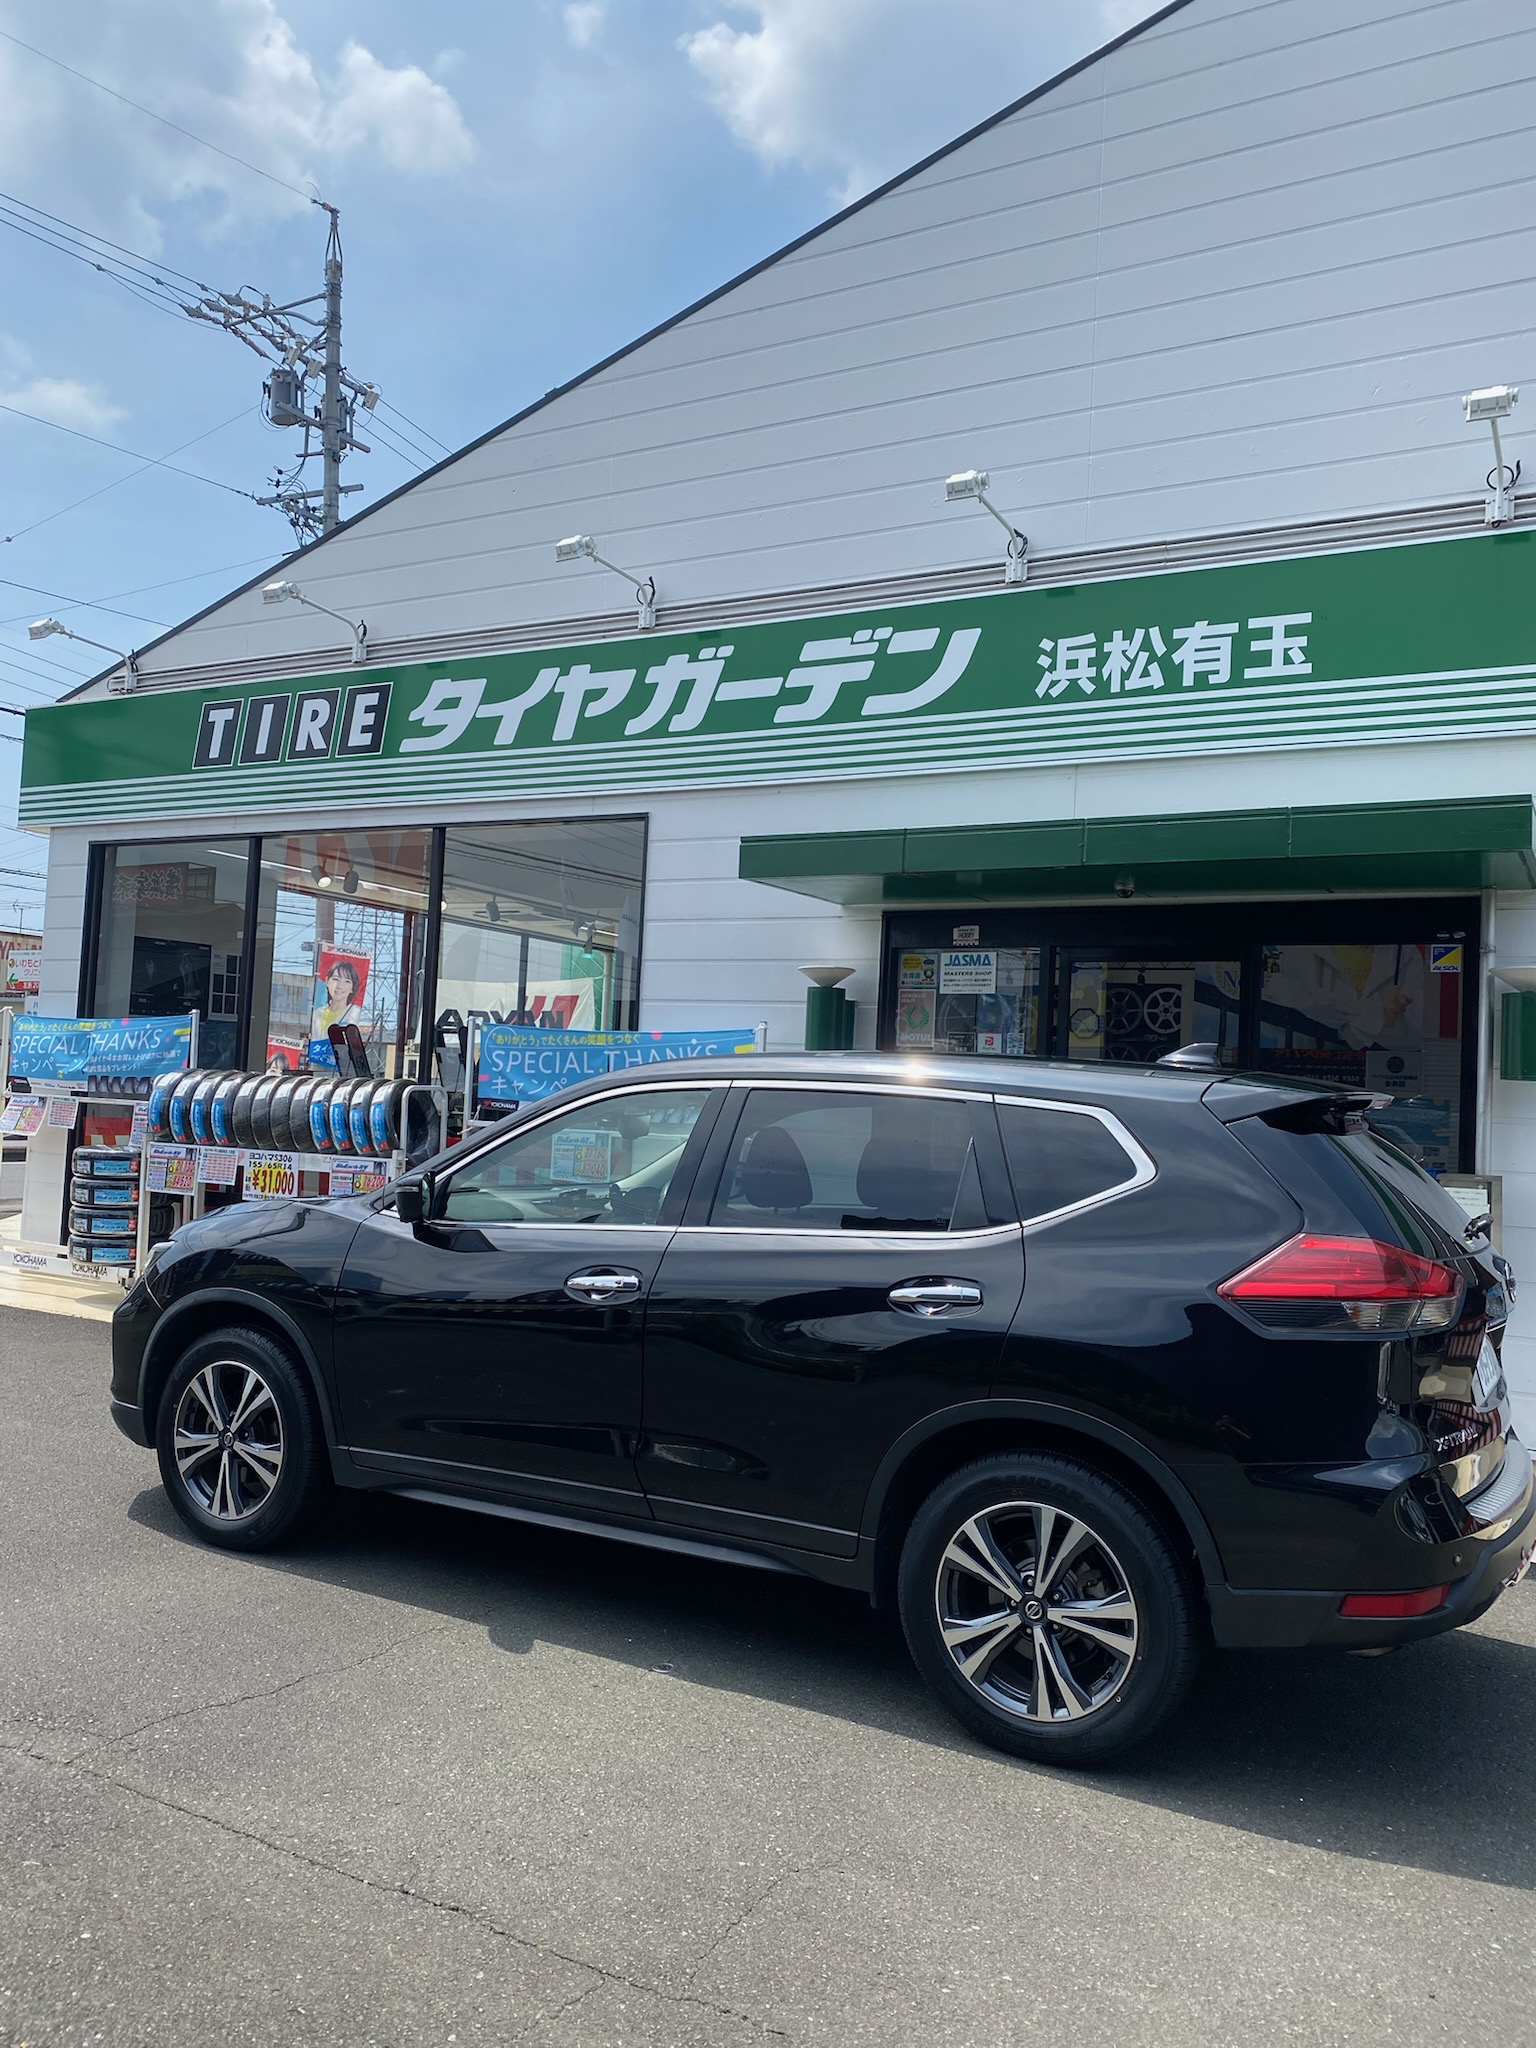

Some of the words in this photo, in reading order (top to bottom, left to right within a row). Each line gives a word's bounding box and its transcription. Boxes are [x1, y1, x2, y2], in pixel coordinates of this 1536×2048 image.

[1035, 611, 1313, 699] 浜松有玉
[398, 627, 982, 753] タイヤガーデン
[208, 692, 380, 759] TIRE
[335, 947, 367, 957] YOKOHAMA
[16, 959, 41, 967] いわもと
[944, 954, 992, 967] JASMA
[12, 1034, 79, 1055] SPECIAL
[87, 1028, 163, 1052] THANKS
[900, 1033, 932, 1041] MOTUL
[12, 1058, 85, 1074] キャンペーン
[491, 1050, 594, 1074] SPECIAL
[249, 1152, 293, 1163] ヨコハマS306
[249, 1161, 293, 1171] 155/65R14
[252, 1169, 295, 1196] ¥31,000
[13, 1253, 47, 1267] YOKOHAMA
[72, 1263, 108, 1277] YOKOHAMA
[1434, 1426, 1479, 1453] X-TRAIL
